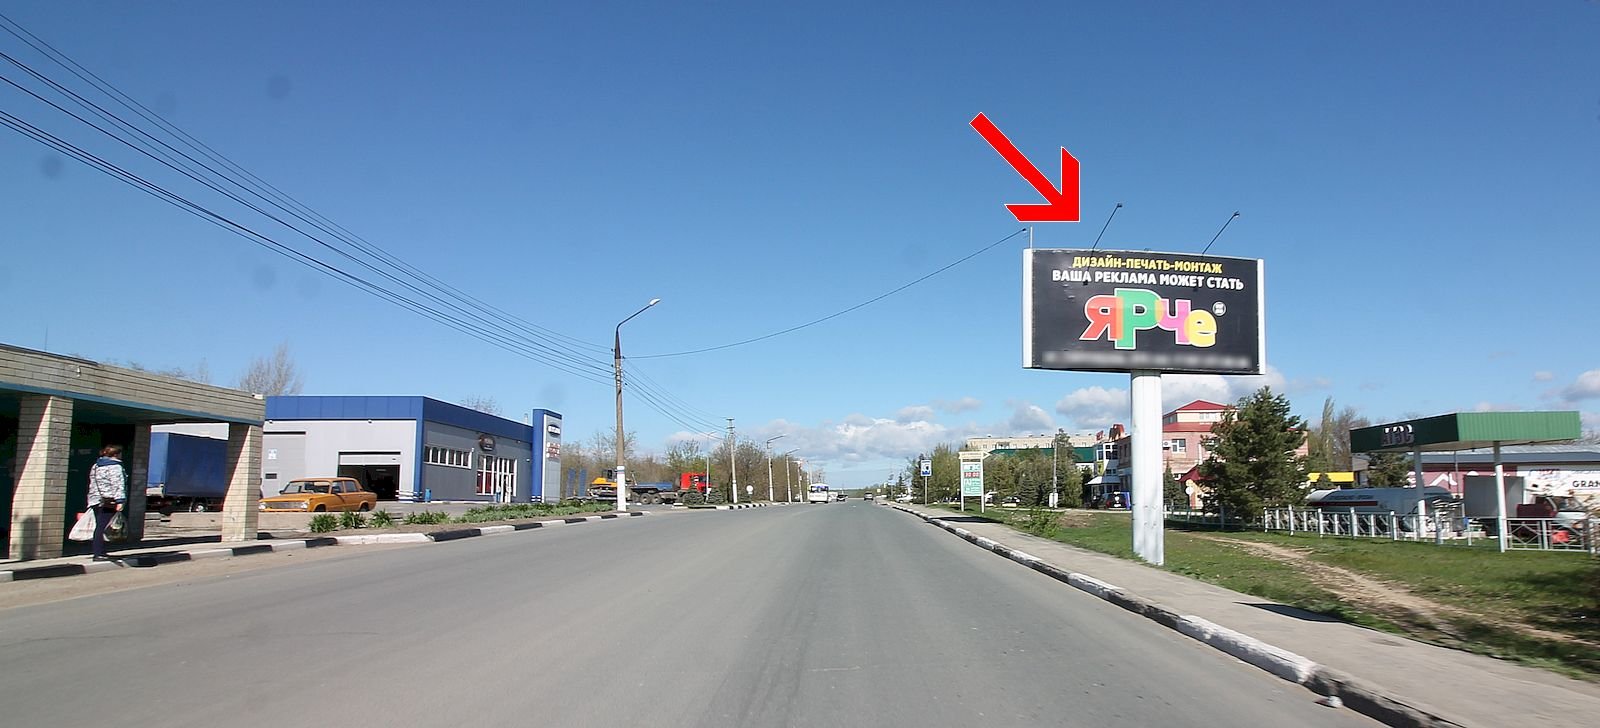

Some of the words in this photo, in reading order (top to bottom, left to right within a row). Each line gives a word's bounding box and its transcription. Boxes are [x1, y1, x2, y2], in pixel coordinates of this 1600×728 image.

[1072, 255, 1223, 274] ДИЗАЙН-ПЕЧАТЬ-МОНТАЖ
[1052, 269, 1091, 283] ВАША
[1094, 271, 1157, 286] РЕКЛАМА
[1159, 275, 1204, 288] МОЖЕТ
[1206, 276, 1245, 291] СТАТЬ
